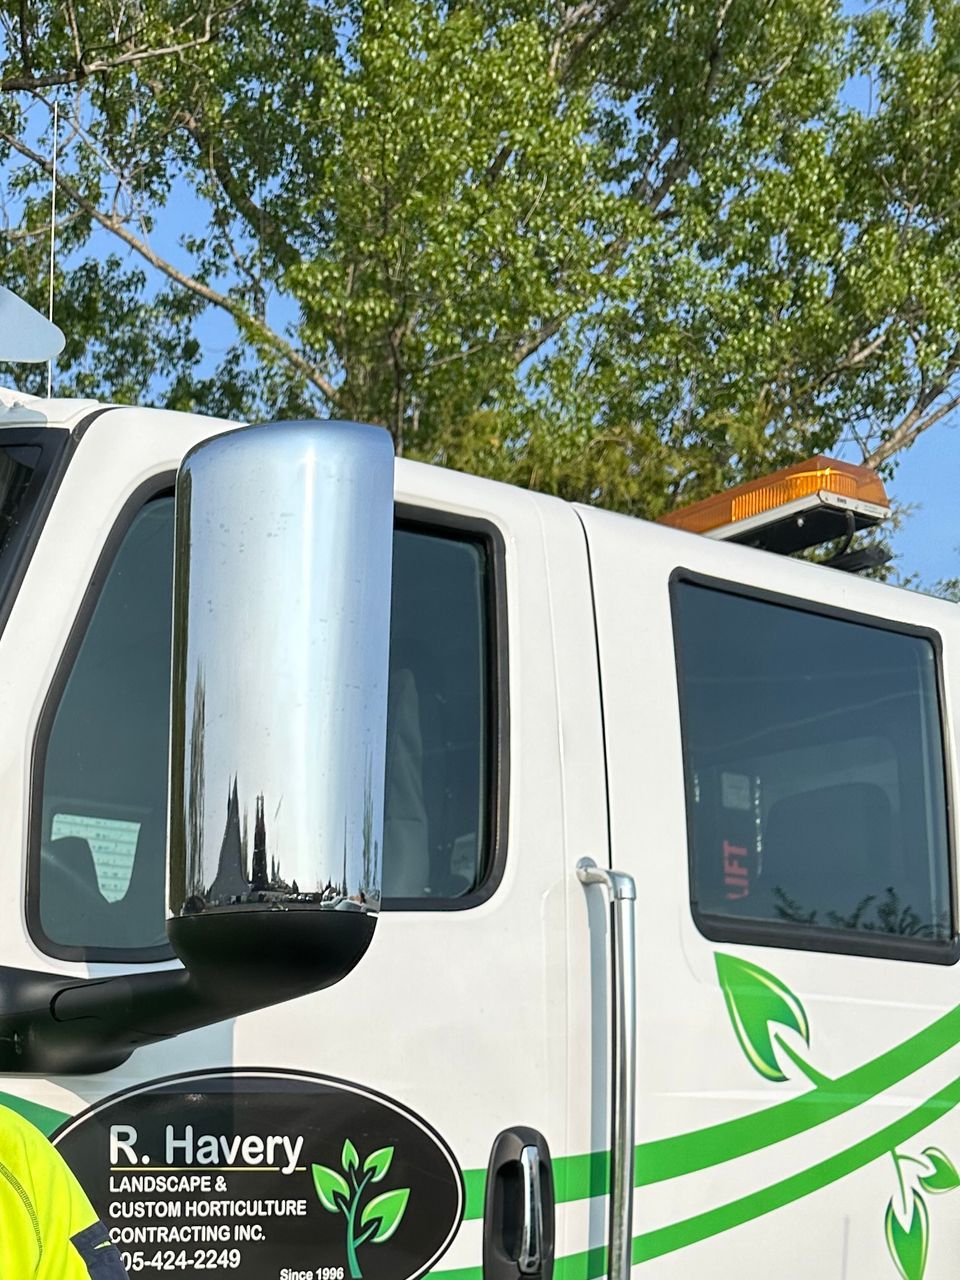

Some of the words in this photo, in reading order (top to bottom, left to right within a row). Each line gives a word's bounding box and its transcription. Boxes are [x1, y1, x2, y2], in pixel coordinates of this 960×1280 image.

[110, 1125, 150, 1164] R.
[166, 1125, 304, 1174] Havery
[109, 1175, 210, 1193] LANDSCAPE
[214, 1175, 228, 1193] &
[109, 1201, 181, 1218] CUSTOM
[185, 1200, 307, 1217] HORTICULTURE
[109, 1226, 230, 1244] CONTRACTING
[233, 1225, 267, 1243] INC.
[120, 1249, 241, 1271] 05-424-2249
[316, 1267, 344, 1280] 1996
